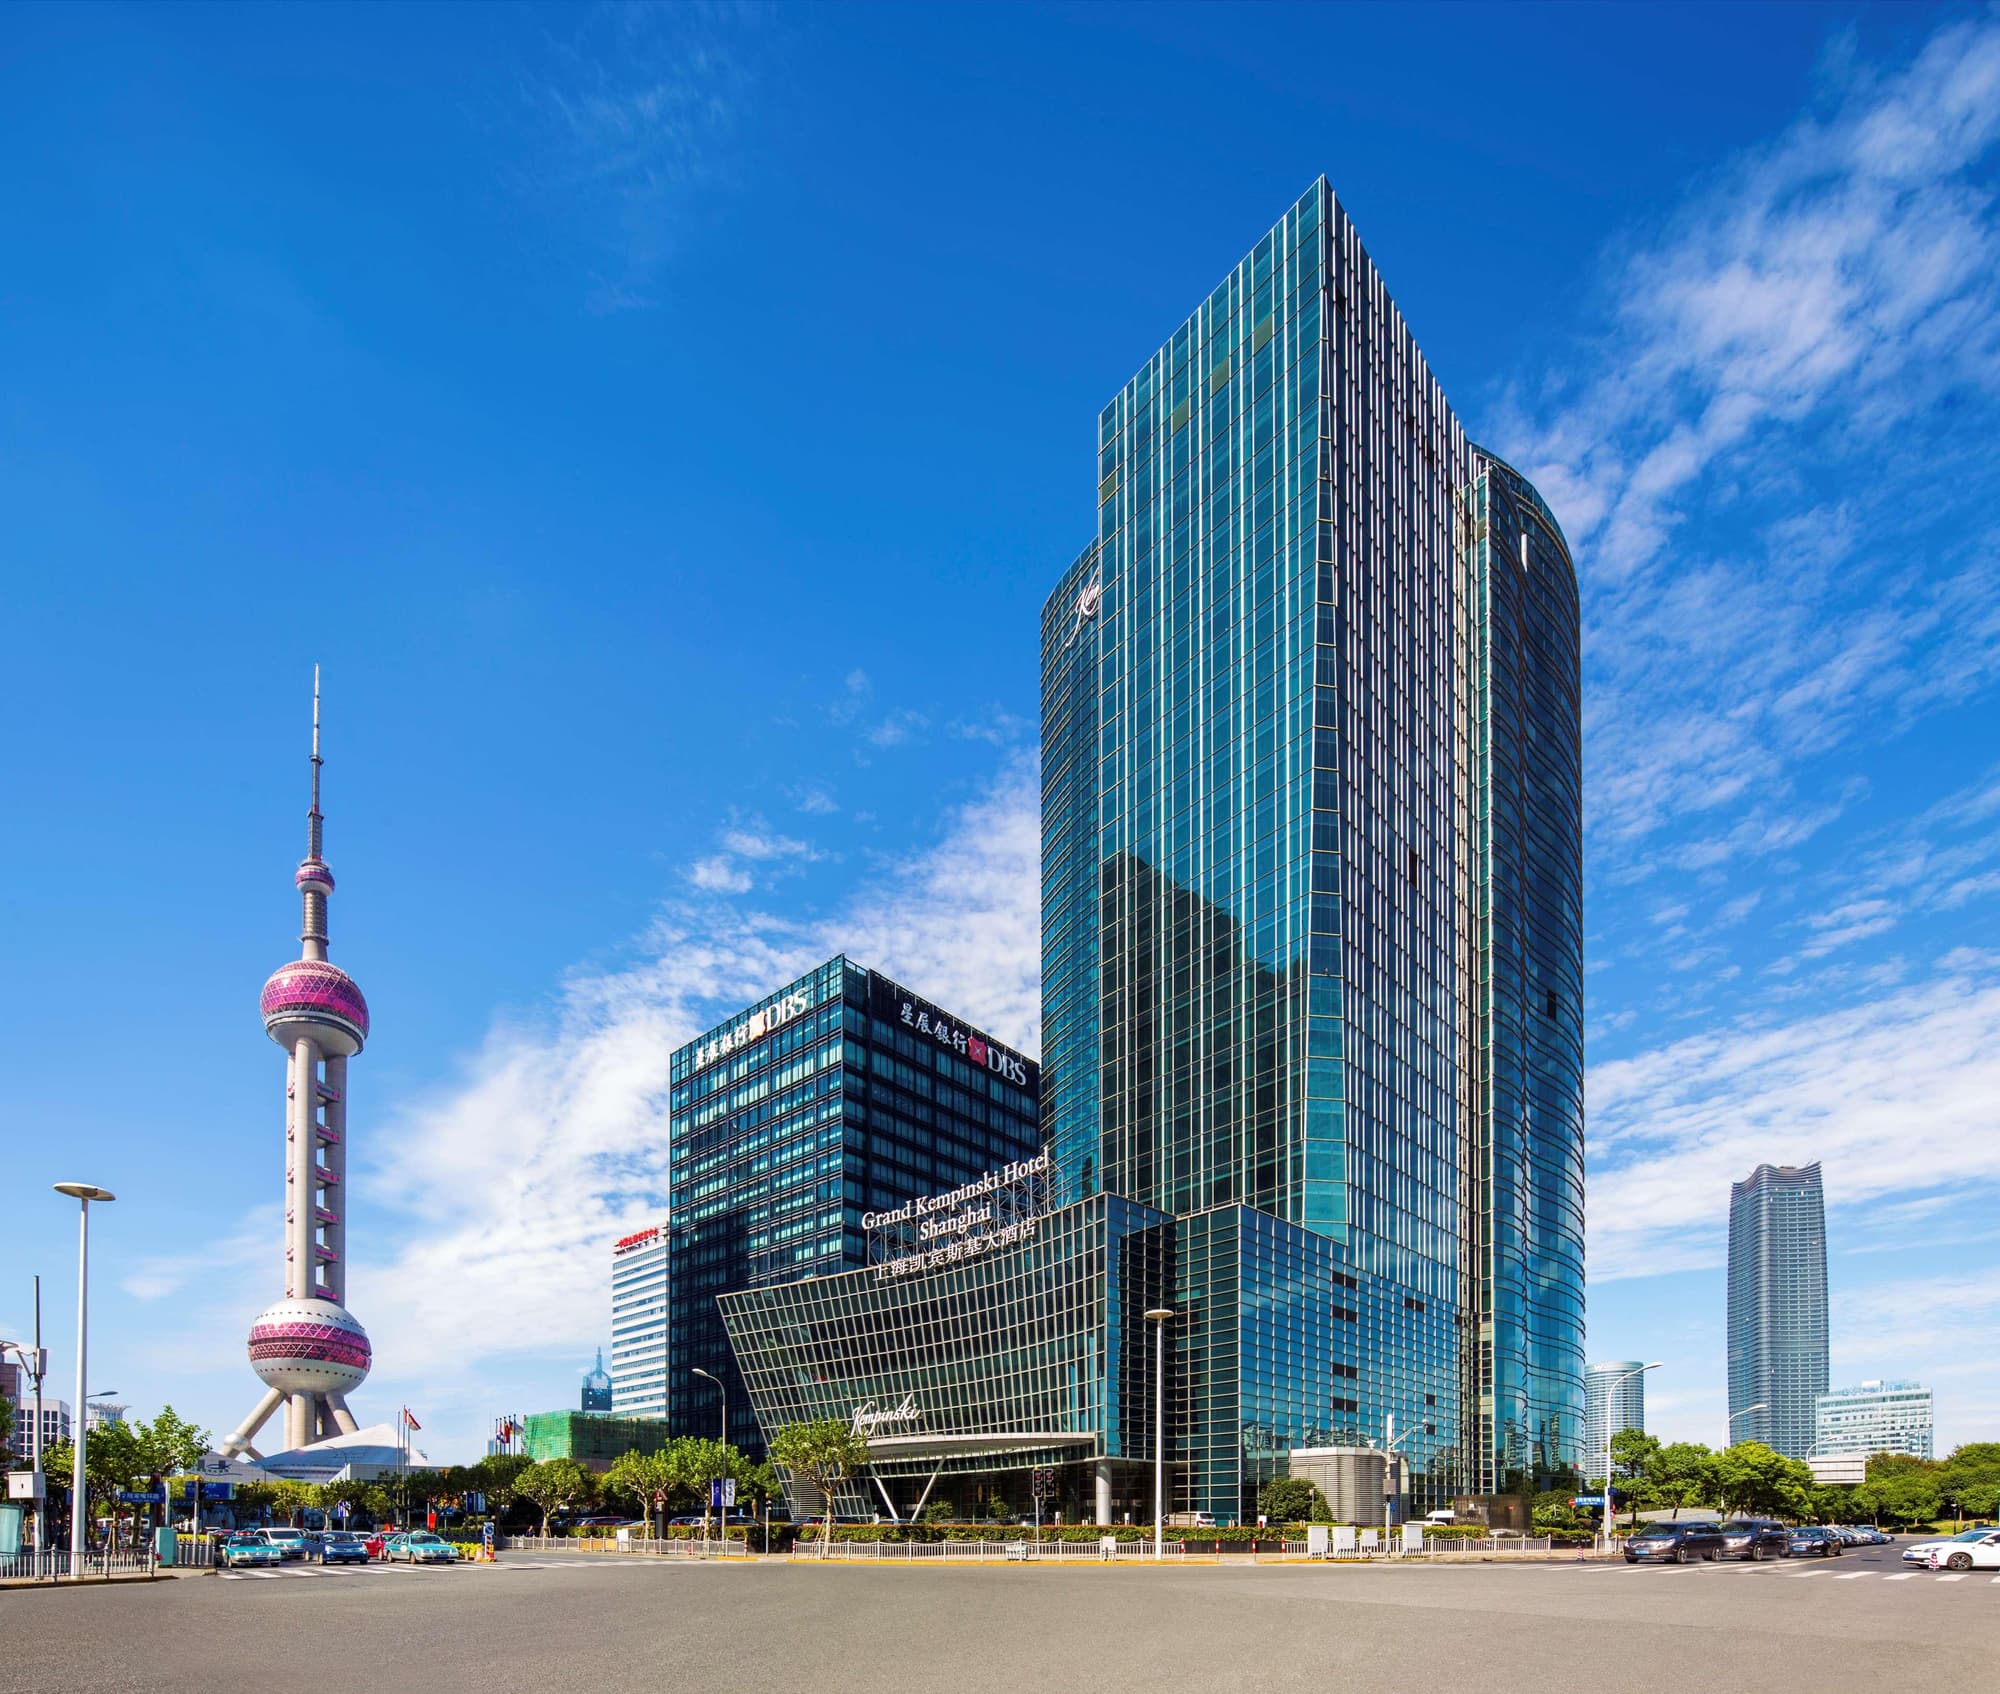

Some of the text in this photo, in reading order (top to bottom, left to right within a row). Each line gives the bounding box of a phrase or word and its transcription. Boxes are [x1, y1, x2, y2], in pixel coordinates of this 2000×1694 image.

[765, 987, 808, 1031] DBS
[987, 1045, 1027, 1086] DBS
[861, 1145, 1050, 1230] Grand Kempinski Hotel
[919, 1201, 992, 1240] Shanghai
[873, 1216, 1038, 1281] 上海凯宾斯基大酒店
[849, 1392, 921, 1438] Kempinski
